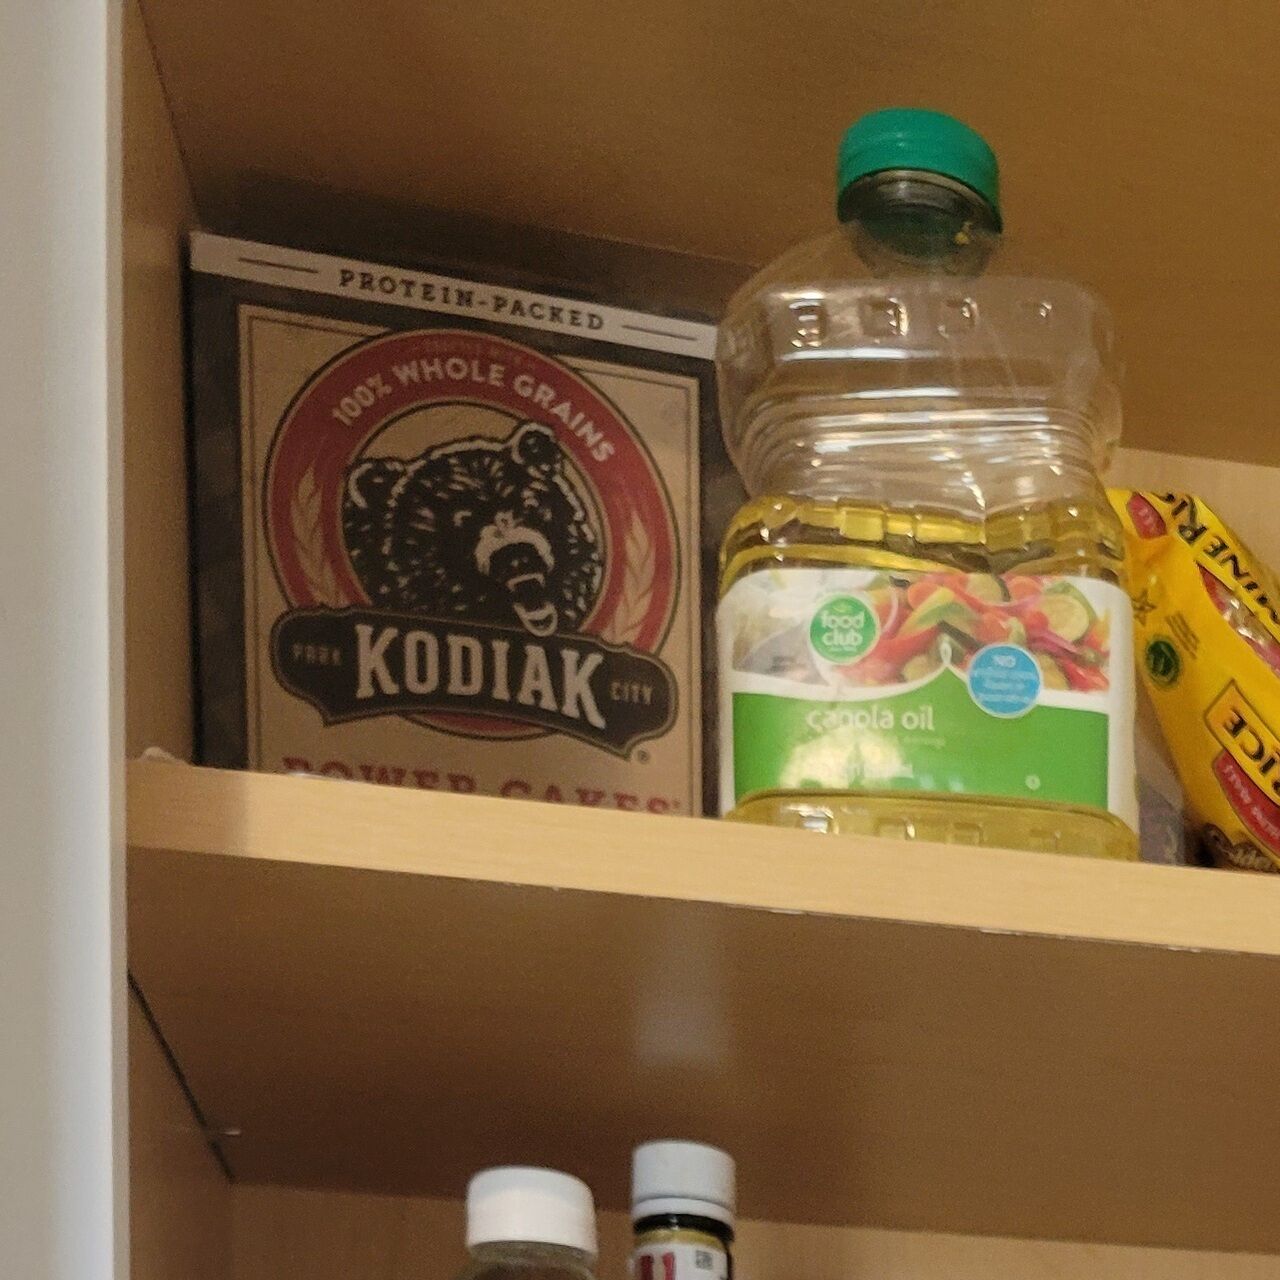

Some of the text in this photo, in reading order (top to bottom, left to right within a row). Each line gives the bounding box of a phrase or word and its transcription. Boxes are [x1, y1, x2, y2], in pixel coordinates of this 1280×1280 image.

[337, 267, 606, 332] PROTEIN-PACKED
[331, 356, 617, 464] 100% WHOLE GRAINS
[820, 609, 866, 629] food
[821, 629, 864, 647] club
[354, 622, 607, 731] KODIAK
[609, 679, 654, 707] CITY
[901, 704, 936, 731] oil
